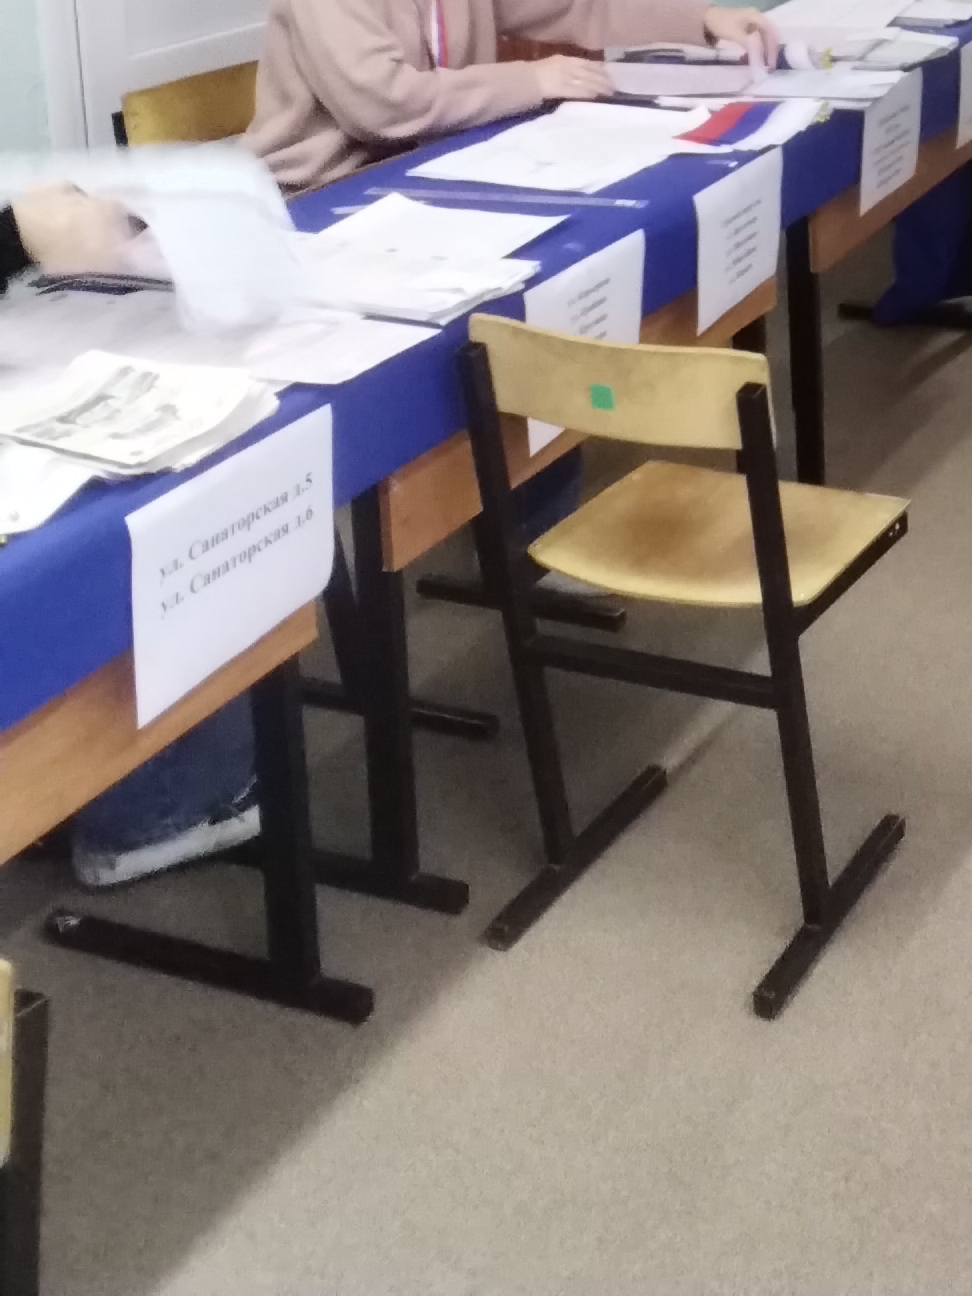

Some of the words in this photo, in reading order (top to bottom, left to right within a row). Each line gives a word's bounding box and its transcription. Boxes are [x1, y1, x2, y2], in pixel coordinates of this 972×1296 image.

[159, 559, 183, 585] ул.
[188, 491, 289, 561] Санаторская
[292, 471, 313, 501] д.5
[161, 591, 184, 620] ул.
[189, 523, 289, 594] Санаторская
[294, 504, 314, 530] д.6
